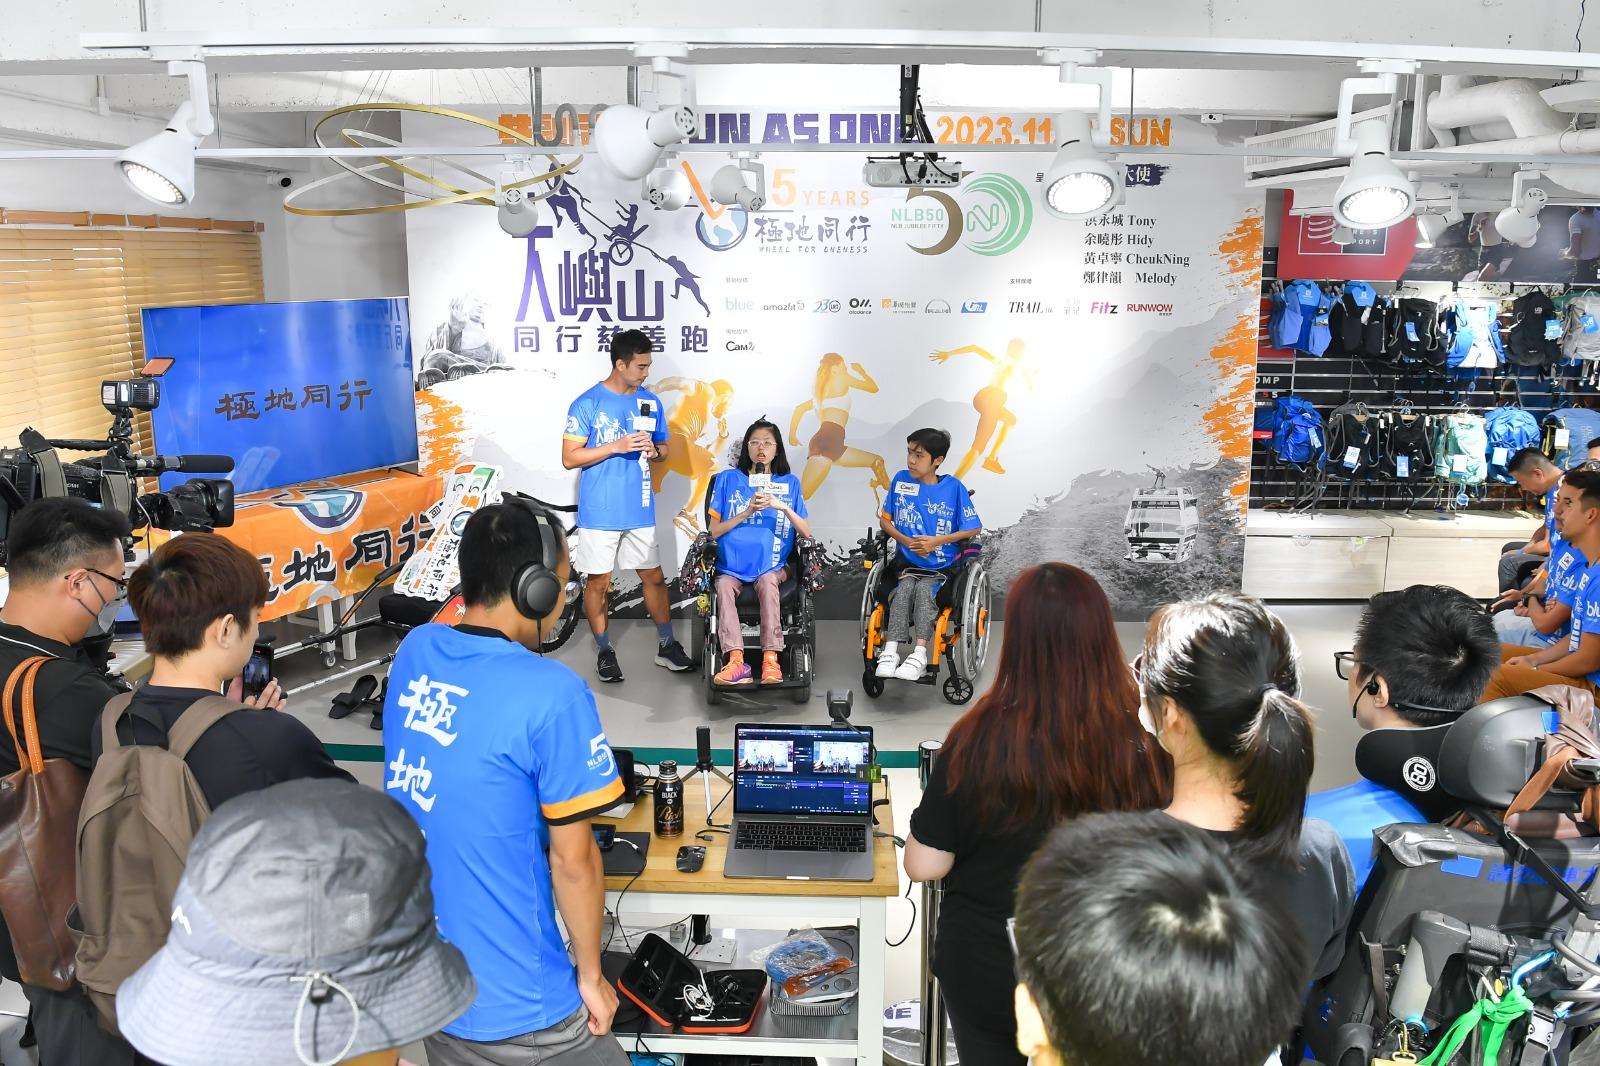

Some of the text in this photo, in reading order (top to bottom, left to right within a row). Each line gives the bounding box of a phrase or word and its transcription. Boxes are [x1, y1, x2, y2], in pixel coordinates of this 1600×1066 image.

[688, 113, 919, 145] UN AS ON
[936, 115, 1057, 145] 2023.11
[1110, 117, 1171, 147] SUN
[771, 169, 872, 207] 5 YEARS
[891, 208, 944, 222] NLB50
[1127, 215, 1156, 228] Tony
[754, 215, 872, 243] 極地同行
[1127, 234, 1154, 248] Hidy
[1126, 253, 1190, 267] CheukNing
[512, 226, 664, 322] 大嶼山
[1135, 272, 1177, 286] Melody
[725, 297, 754, 311] blue
[1008, 301, 1044, 314] TRAIL
[1090, 301, 1119, 314] Fitz
[1126, 303, 1174, 312] RUNWOW
[215, 380, 373, 421] 極地同行
[387, 674, 469, 813] 極地
[661, 791, 678, 799] BLACK
